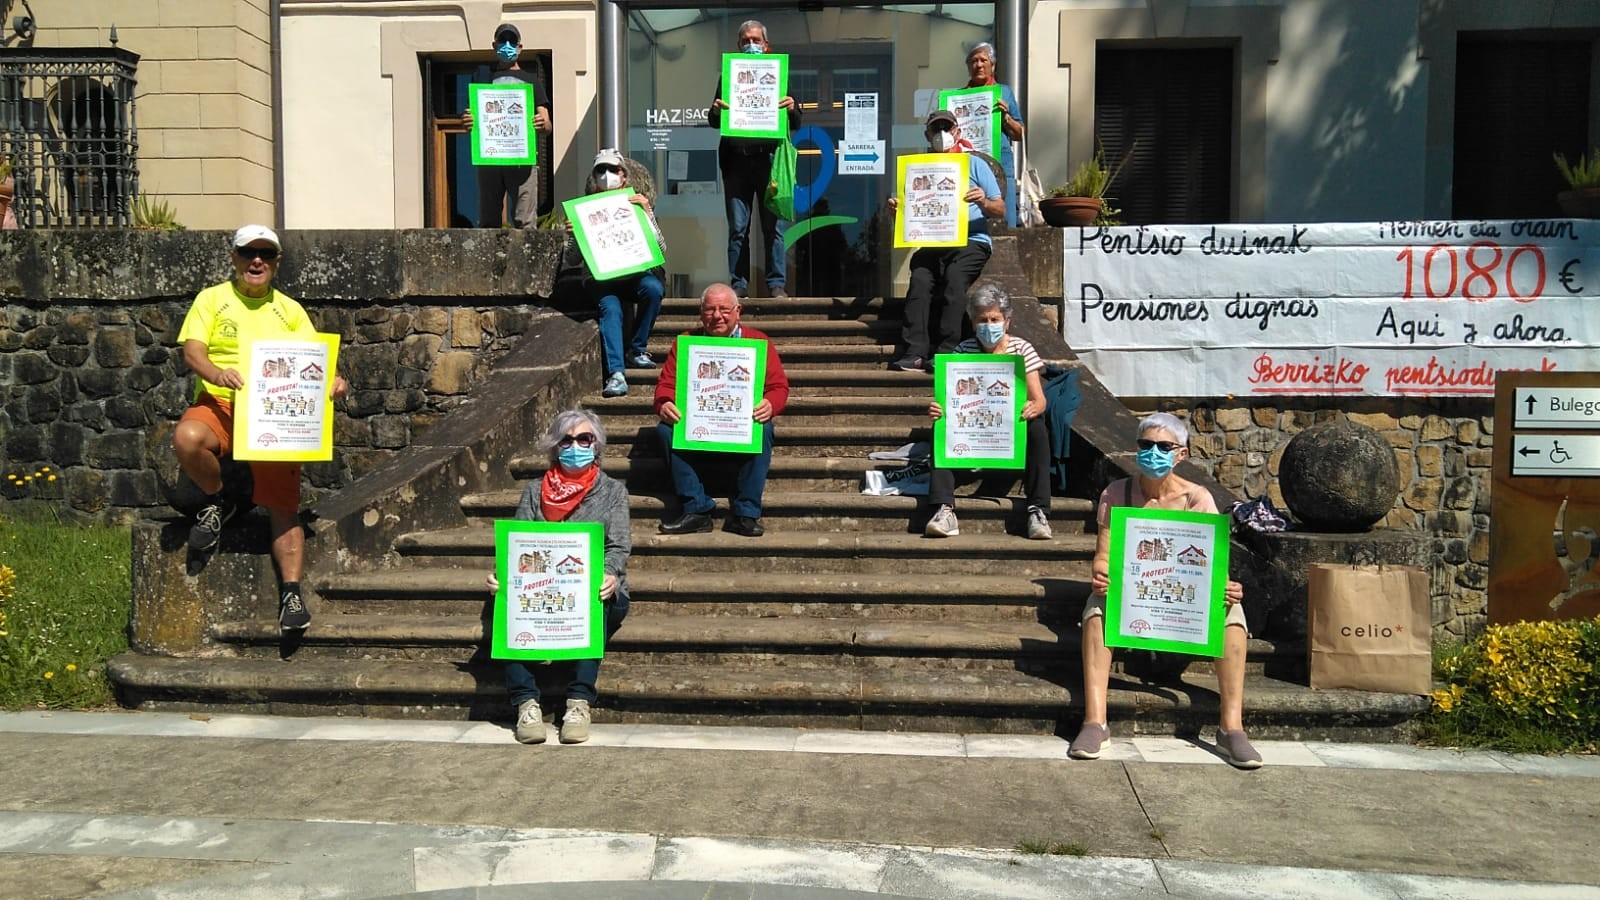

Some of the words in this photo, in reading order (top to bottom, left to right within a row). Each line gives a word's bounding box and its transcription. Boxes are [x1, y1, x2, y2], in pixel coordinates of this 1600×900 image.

[1200, 224, 1312, 256] duinak
[1470, 220, 1501, 237] eta
[1396, 241, 1546, 303] 1080
[1558, 259, 1584, 294] €
[1080, 283, 1209, 323] Pensiones
[1225, 291, 1319, 330] dignas
[1376, 306, 1445, 344] Aqui
[1463, 322, 1478, 343] y
[1494, 313, 1572, 342] ahora.
[1248, 352, 1370, 384] Berrizko
[524, 577, 554, 591] PROTESTA!
[1141, 566, 1175, 578] PROTESTA!
